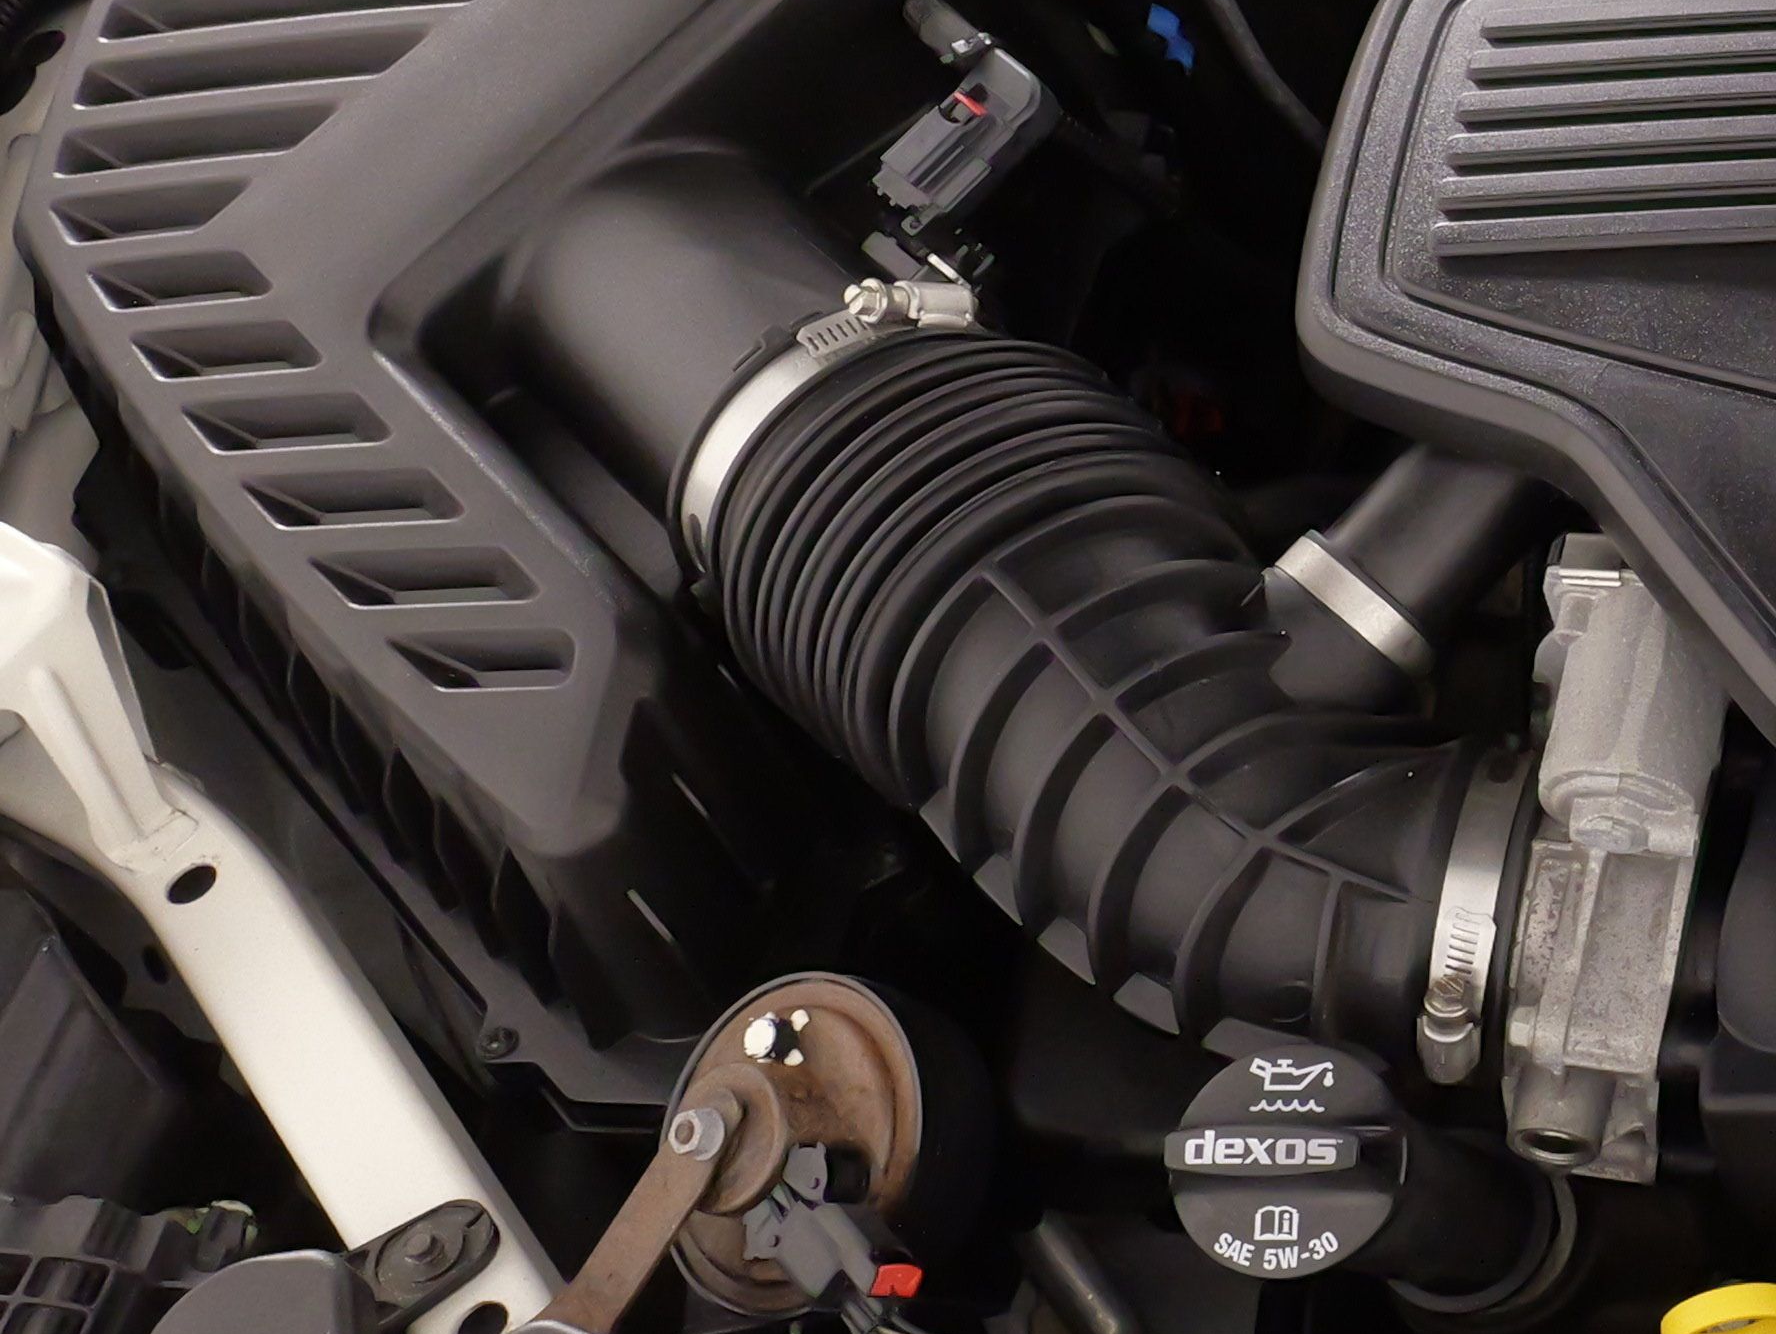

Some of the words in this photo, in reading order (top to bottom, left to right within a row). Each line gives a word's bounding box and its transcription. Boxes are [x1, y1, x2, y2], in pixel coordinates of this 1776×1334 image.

[1184, 1129, 1337, 1165] dexos
[1213, 1232, 1255, 1267] SAE
[1262, 1231, 1339, 1270] 5W-30
